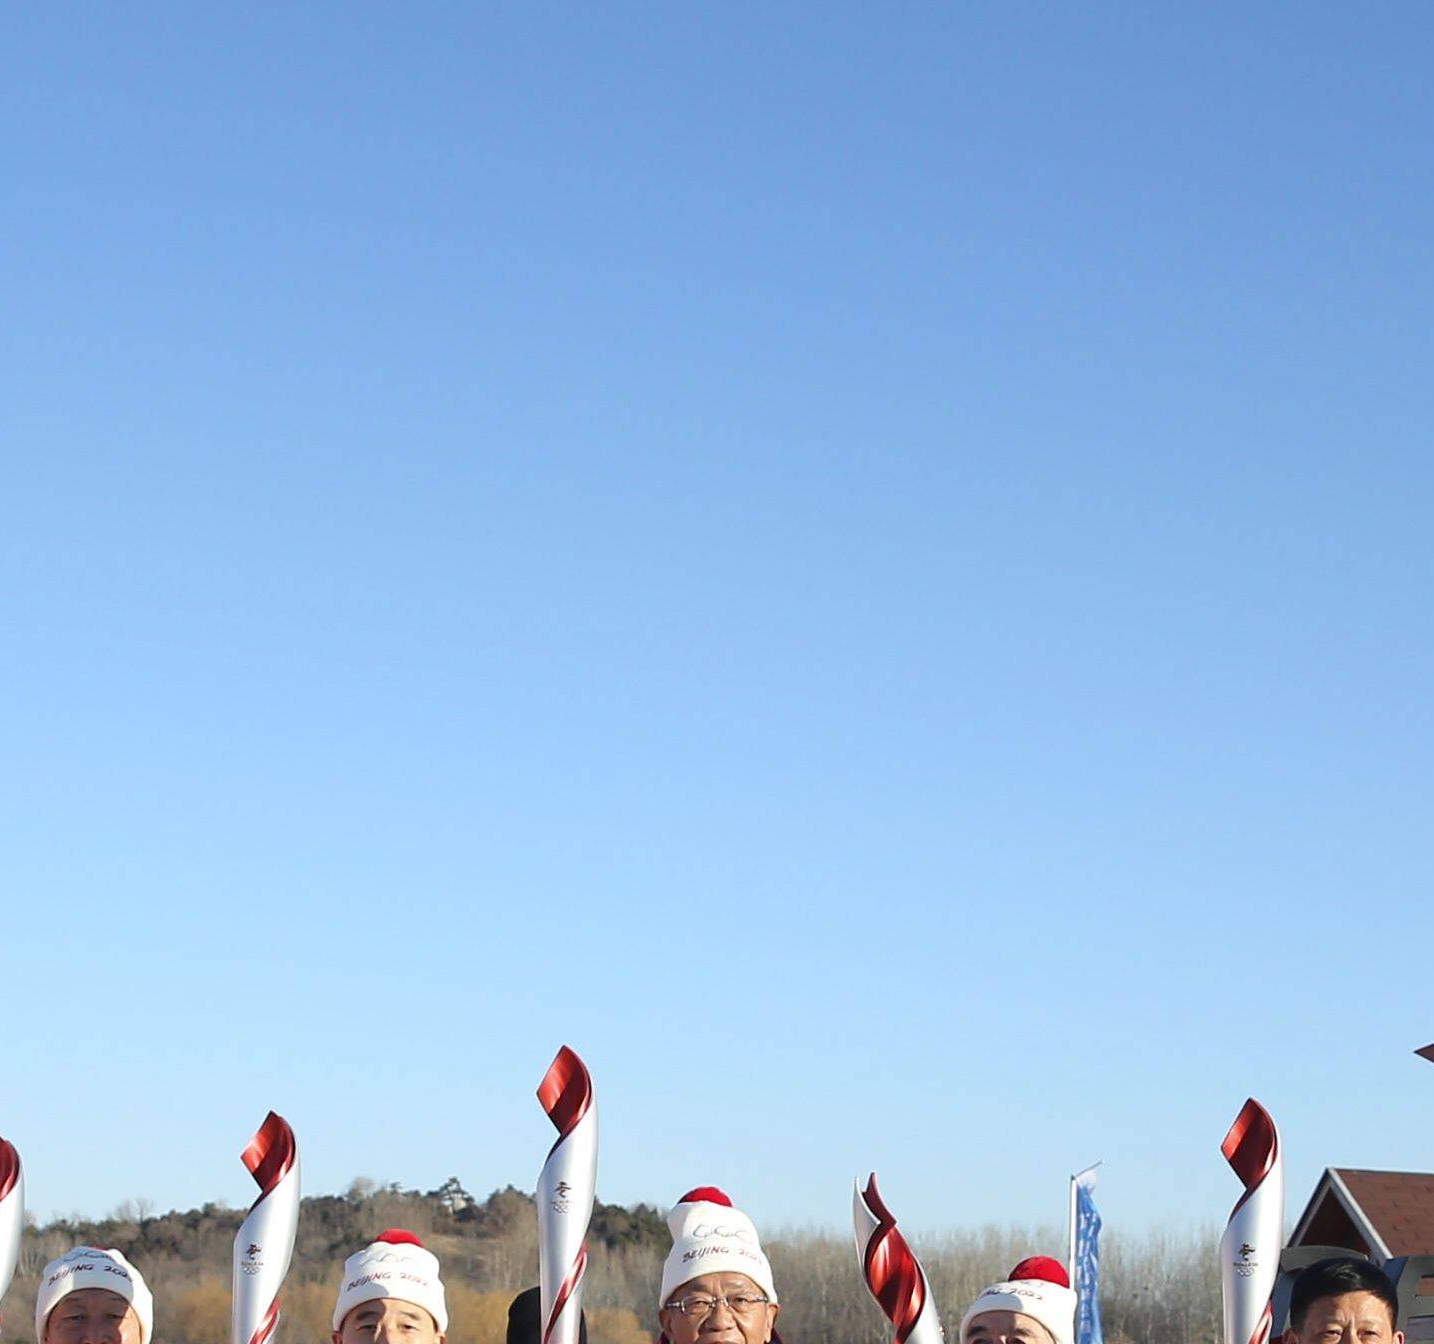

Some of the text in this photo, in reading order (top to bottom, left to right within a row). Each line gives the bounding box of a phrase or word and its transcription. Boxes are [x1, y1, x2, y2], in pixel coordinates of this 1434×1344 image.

[682, 1246, 730, 1263] BEIJING
[48, 1263, 95, 1286] BEIJING
[347, 1271, 391, 1292] BEIJING
